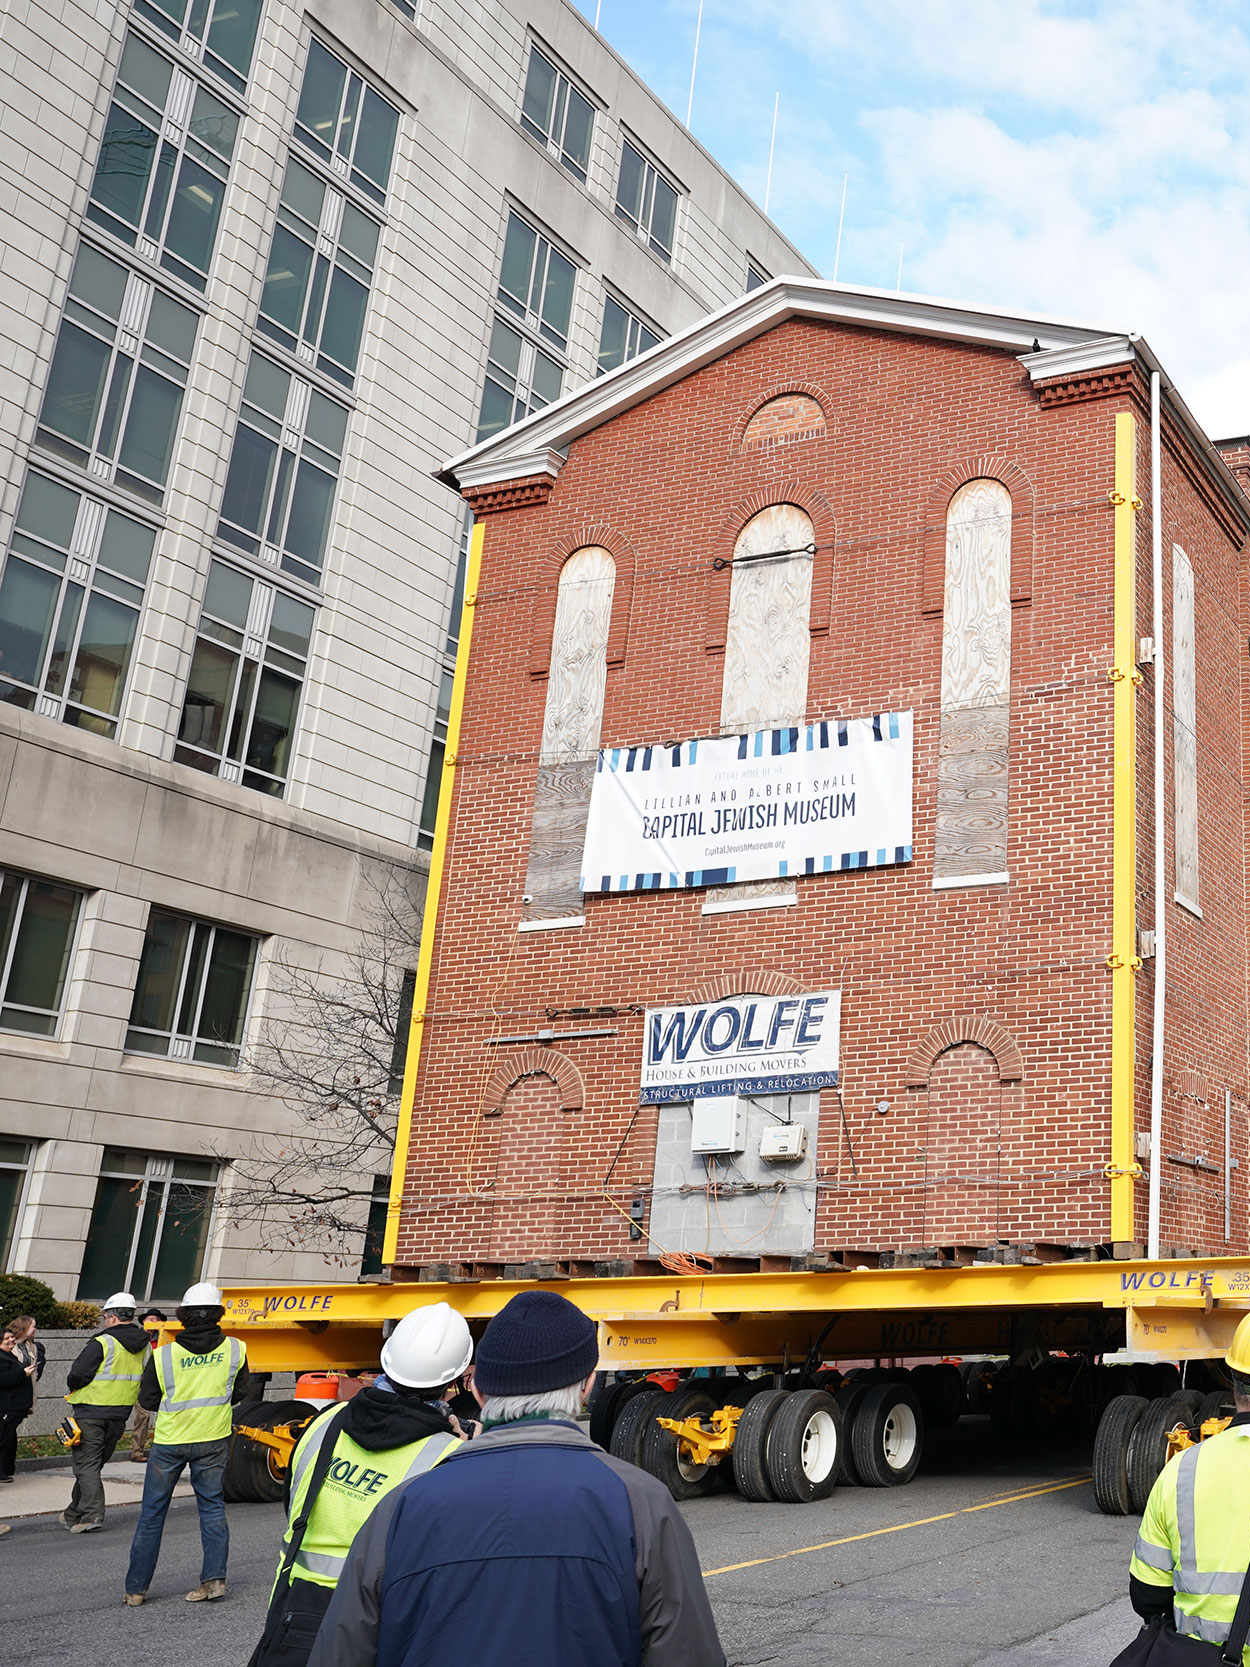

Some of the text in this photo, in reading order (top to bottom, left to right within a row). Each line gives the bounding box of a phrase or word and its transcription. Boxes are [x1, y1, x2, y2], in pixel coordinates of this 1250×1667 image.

[741, 768, 760, 778] HOME
[762, 767, 771, 777] OF
[644, 773, 856, 810] LILLIAN AND ALBERT SMALL
[642, 792, 856, 840] CAPITAL JEWISH MUSEUM
[647, 997, 829, 1066] WOLFE
[646, 1057, 807, 1081] HOUSE & BUILDING MOVERS
[644, 1075, 831, 1099] STRUCTURAL LIFTING & RELOCATION
[1120, 1270, 1215, 1291] WOLFE
[238, 1299, 252, 1308] 35'
[264, 1295, 334, 1311] WOLFE
[619, 1336, 631, 1346] 70'
[881, 1321, 949, 1345] WOLFE
[181, 1353, 224, 1368] WOLFE
